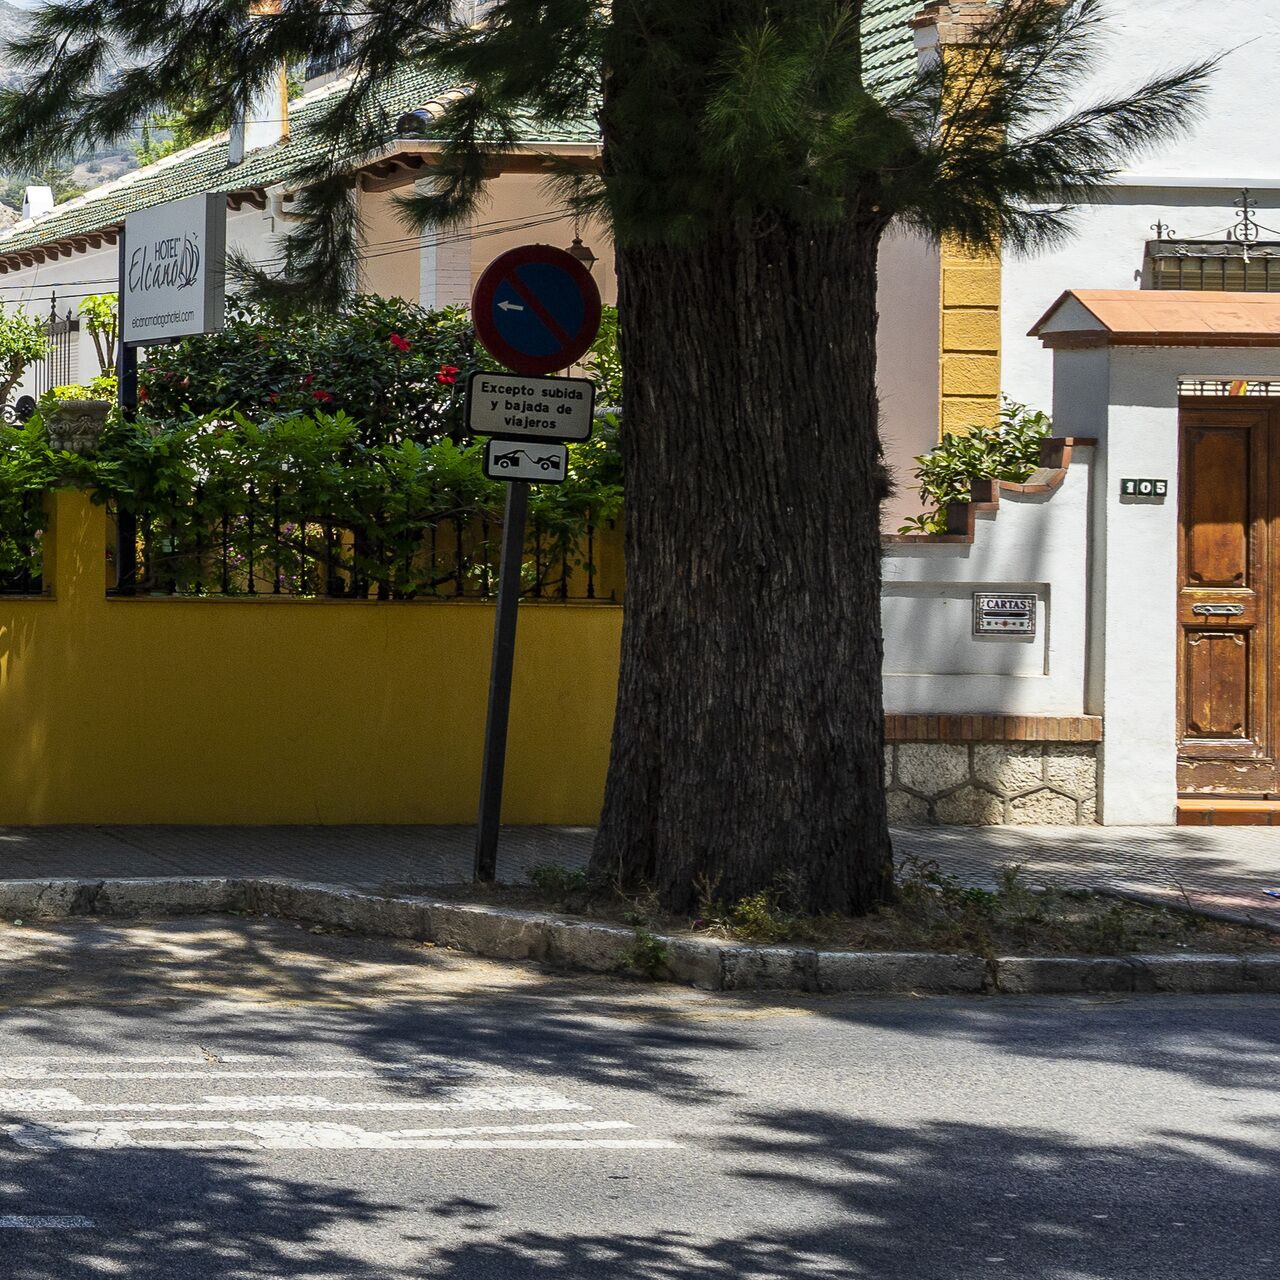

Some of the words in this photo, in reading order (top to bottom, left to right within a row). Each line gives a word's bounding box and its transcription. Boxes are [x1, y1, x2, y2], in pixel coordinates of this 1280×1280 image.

[128, 246, 179, 293] Elcano
[481, 381, 534, 397] Excepto
[541, 388, 583, 400] subida
[490, 400, 498, 411] y
[504, 400, 549, 413] bajada
[556, 404, 572, 415] de
[504, 416, 557, 429] viajeros
[1126, 481, 1166, 494] 105
[986, 599, 1027, 609] CARTAS
